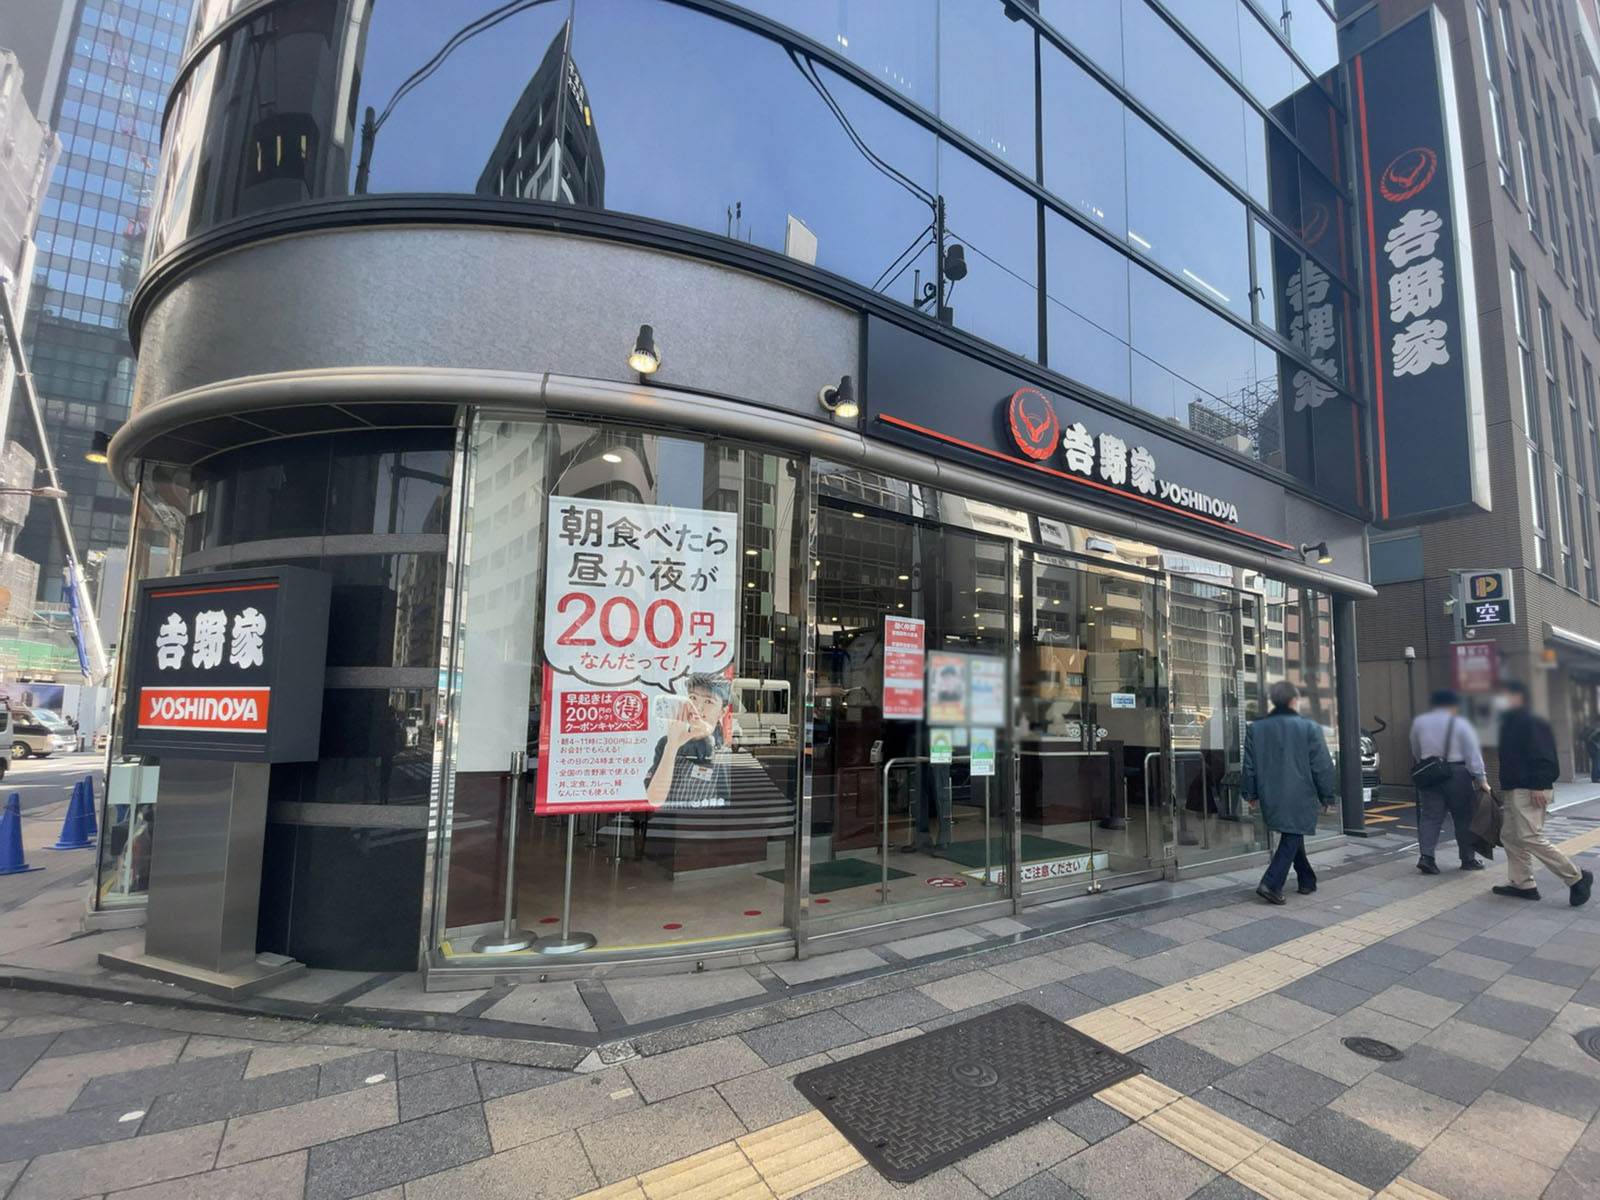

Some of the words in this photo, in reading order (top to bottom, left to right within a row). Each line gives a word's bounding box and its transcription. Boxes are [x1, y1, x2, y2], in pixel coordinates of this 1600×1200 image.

[1384, 209, 1450, 377] 吉野家
[1063, 421, 1157, 496] 吉野家
[1158, 478, 1239, 524] YOSHINOYA
[558, 505, 729, 556] 朝食べたら
[567, 552, 720, 593] 昼か夜が
[1476, 577, 1498, 597] P
[1476, 603, 1500, 623] 空
[156, 607, 267, 670] 吉野家
[580, 651, 680, 672] なんだって!
[150, 696, 259, 722] YOSHINOYA
[565, 694, 612, 705] 早起きは
[565, 721, 645, 732] クーポンキャンペーン
[1020, 861, 1081, 882] ご注意ください
